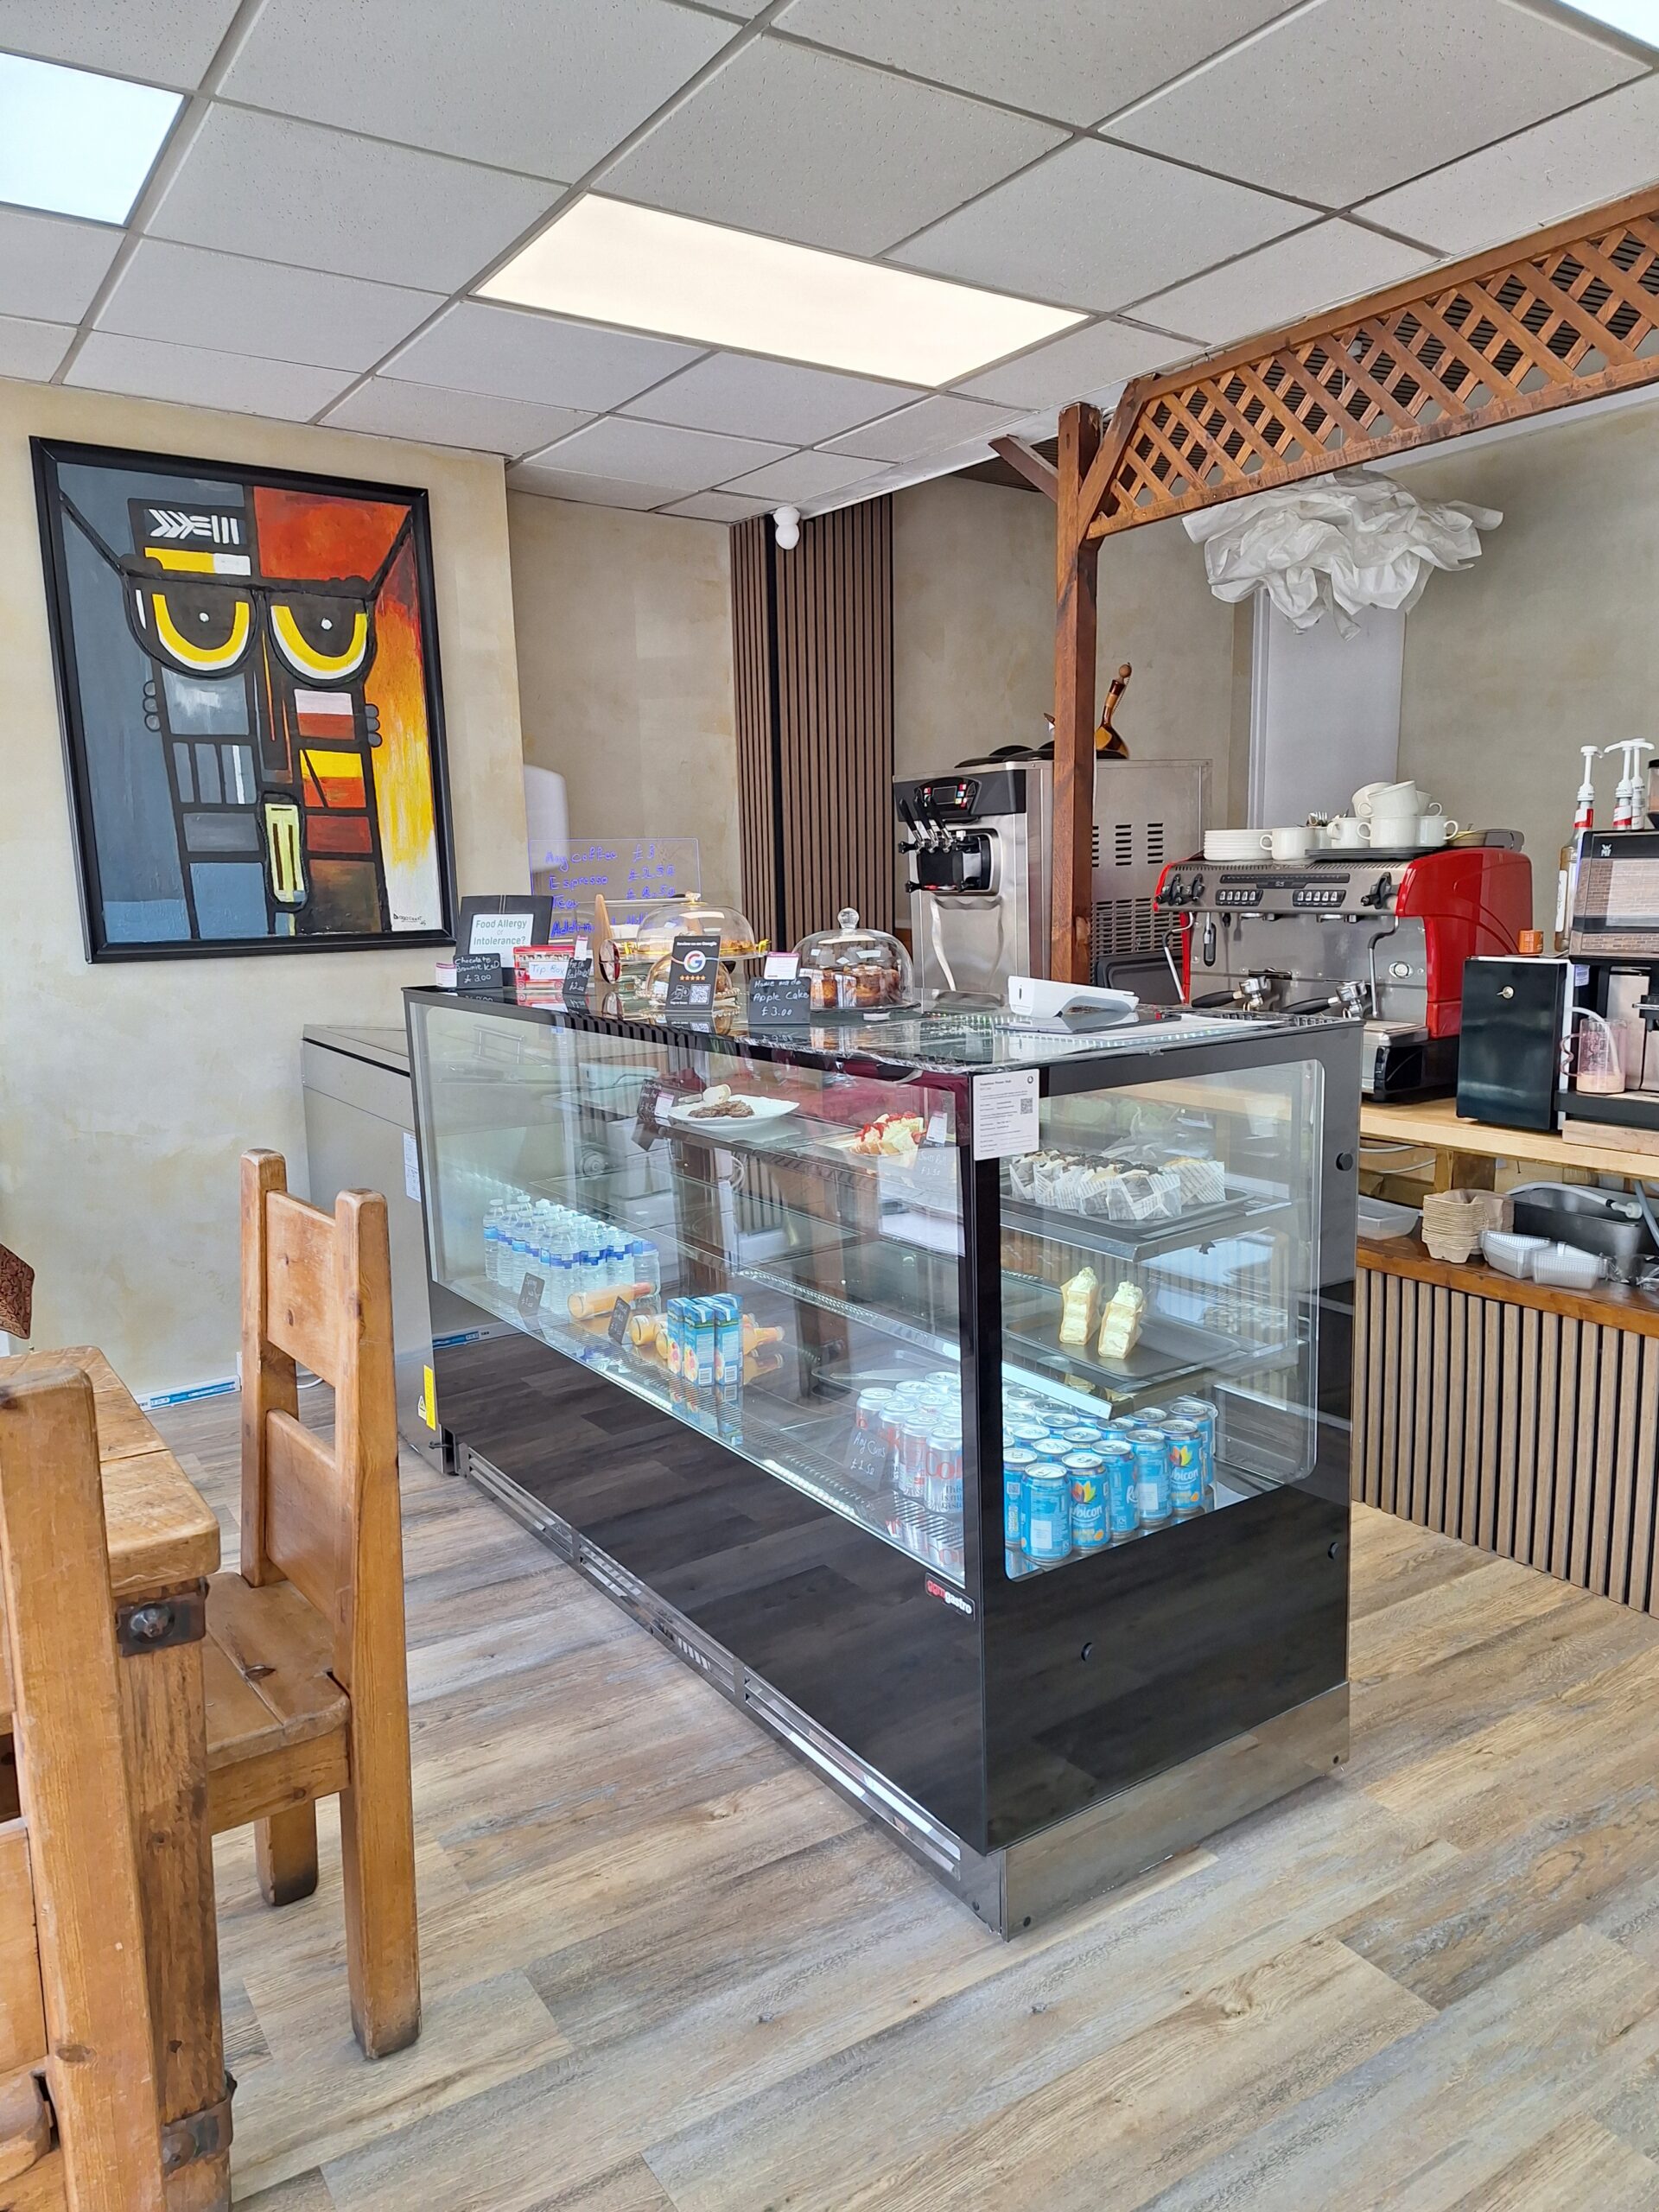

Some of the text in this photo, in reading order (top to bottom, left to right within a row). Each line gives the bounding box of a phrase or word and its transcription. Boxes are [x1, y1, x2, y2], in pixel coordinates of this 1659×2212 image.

[550, 875, 608, 891] Espresso
[475, 918, 528, 930] Food Allergy
[474, 936, 526, 946] Intolerance?
[454, 956, 492, 966] Chocolate
[455, 963, 483, 973] Brownie
[753, 989, 810, 1003] Apple Cake
[761, 1006, 793, 1016] £3.00
